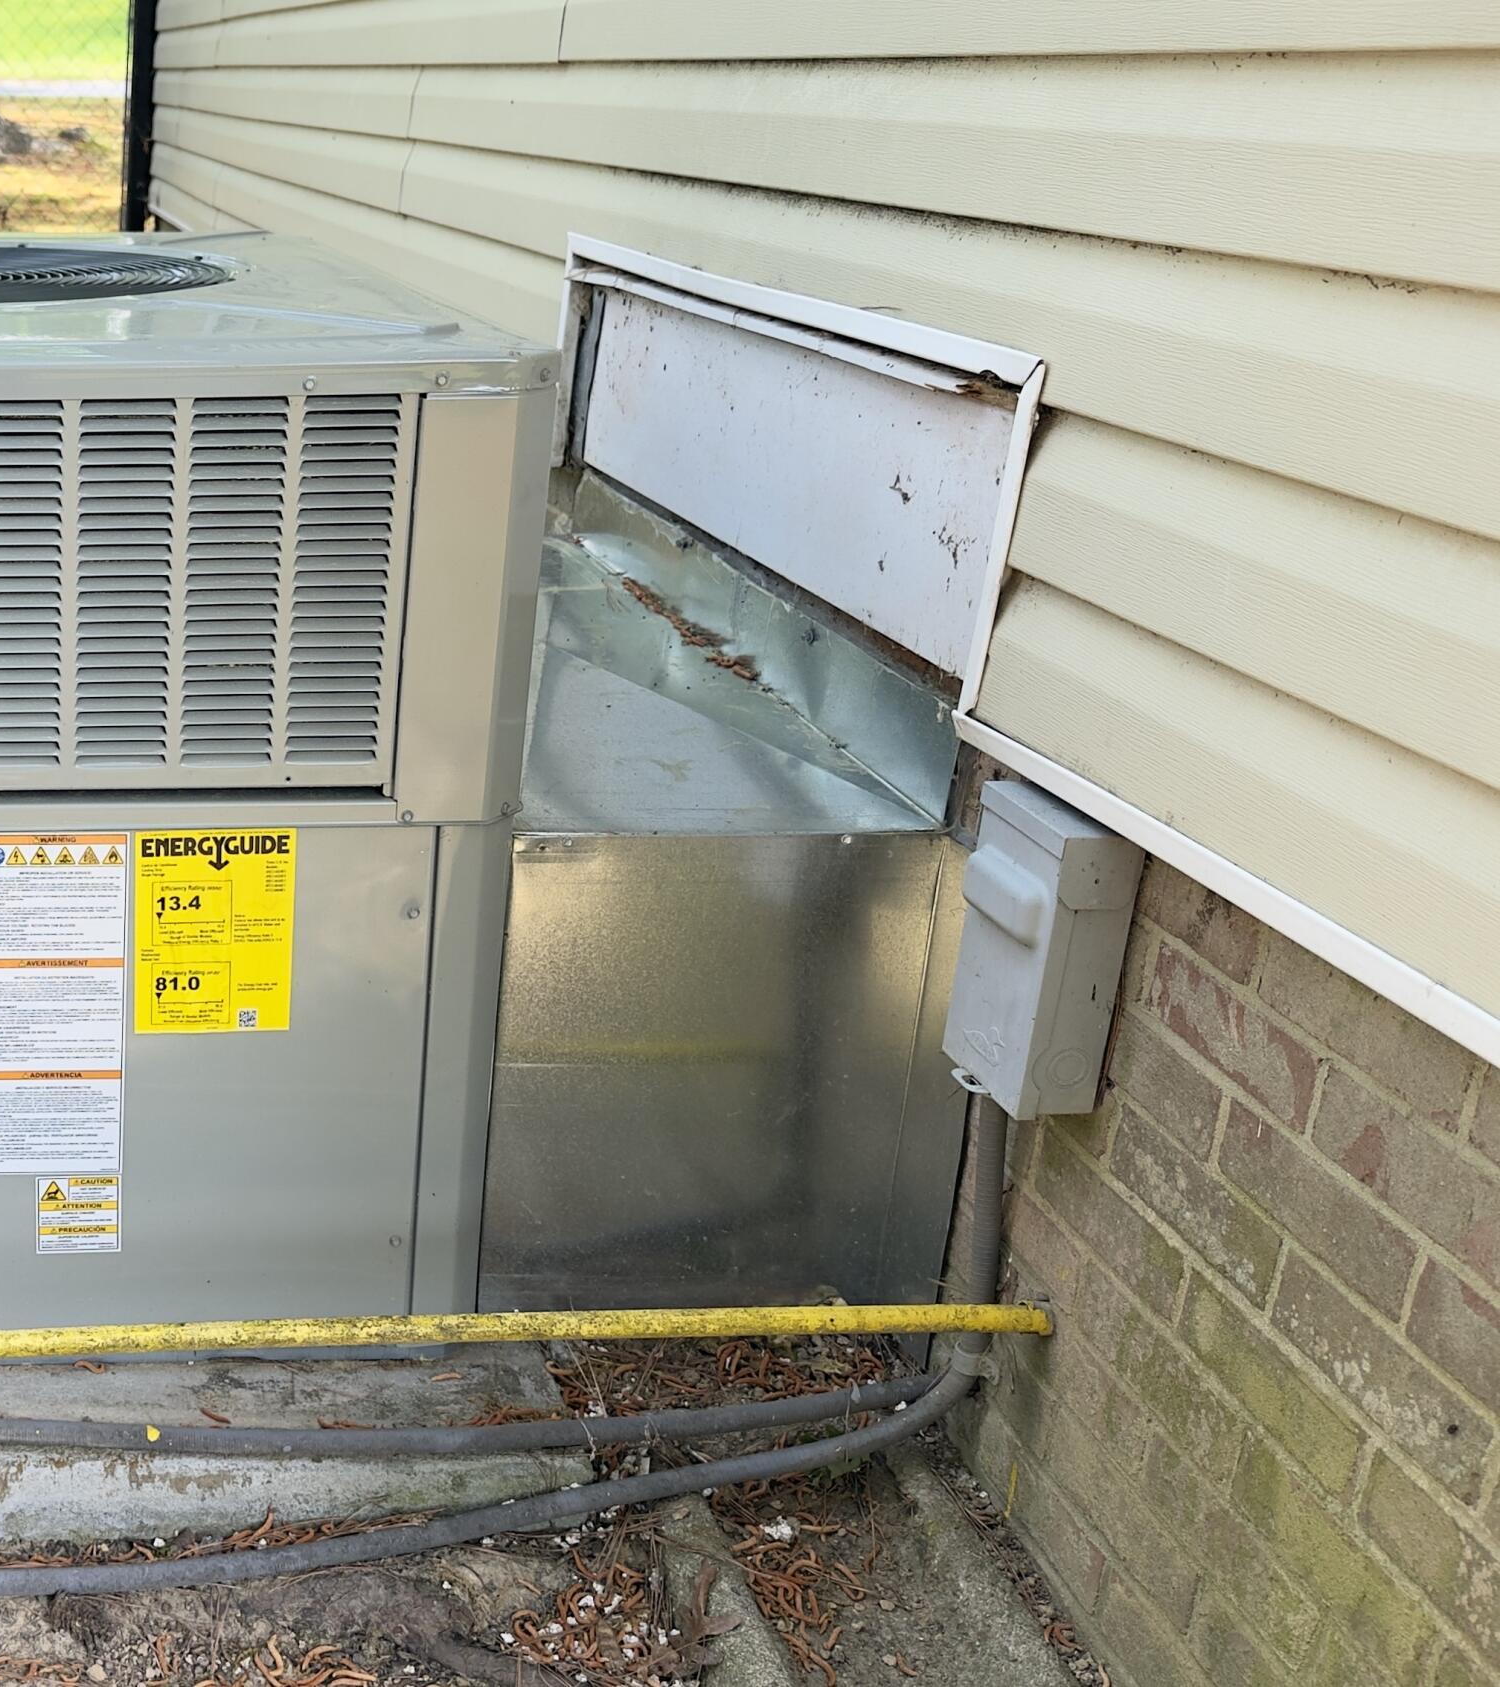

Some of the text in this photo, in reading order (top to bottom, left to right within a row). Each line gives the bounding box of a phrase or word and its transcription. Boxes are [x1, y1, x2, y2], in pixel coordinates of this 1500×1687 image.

[141, 835, 290, 858] ENERGYGUIDE
[156, 895, 202, 911] 13.4
[155, 976, 200, 991] 81.0
[58, 1225, 106, 1233] PRECAUCIÓN
